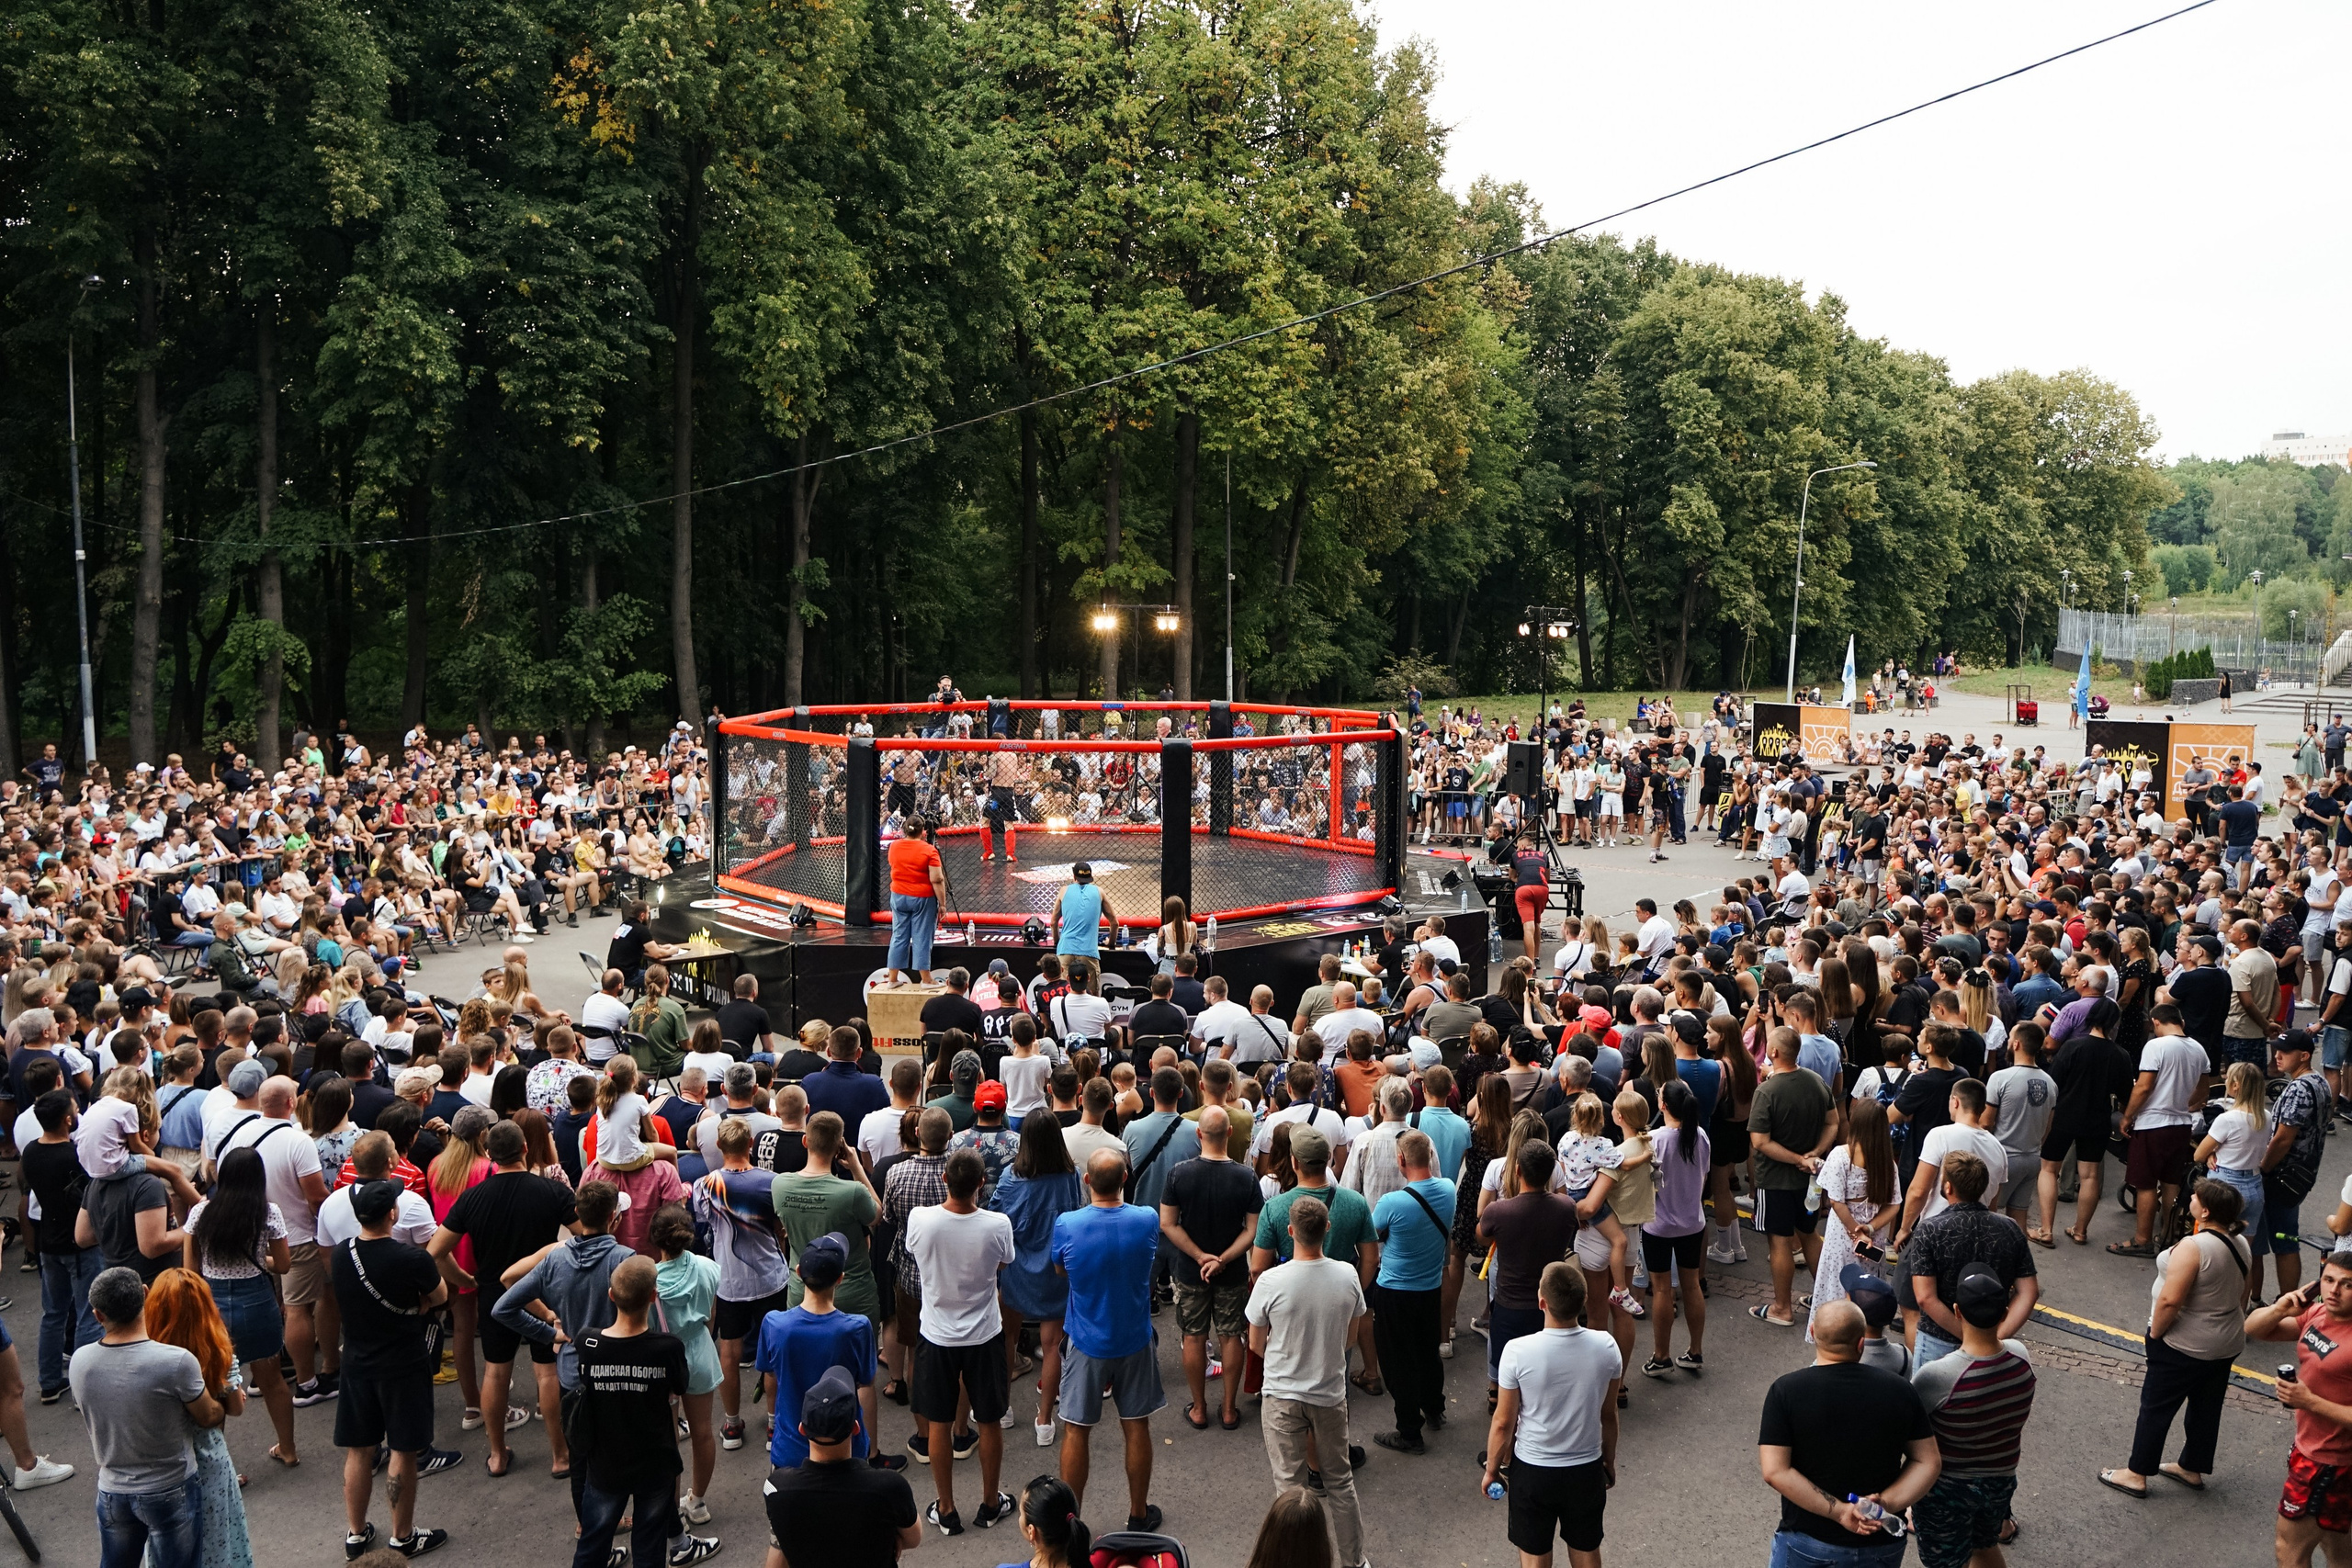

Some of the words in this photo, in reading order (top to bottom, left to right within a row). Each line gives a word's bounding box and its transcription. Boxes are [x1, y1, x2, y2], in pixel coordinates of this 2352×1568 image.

[785, 1195, 813, 1203] adidas
[631, 1366, 667, 1380] ОБОРОНА
[594, 1382, 605, 1391] ВСЕ
[605, 1382, 620, 1393] ИДЕТ
[629, 1382, 649, 1393] ПЛАНУ
